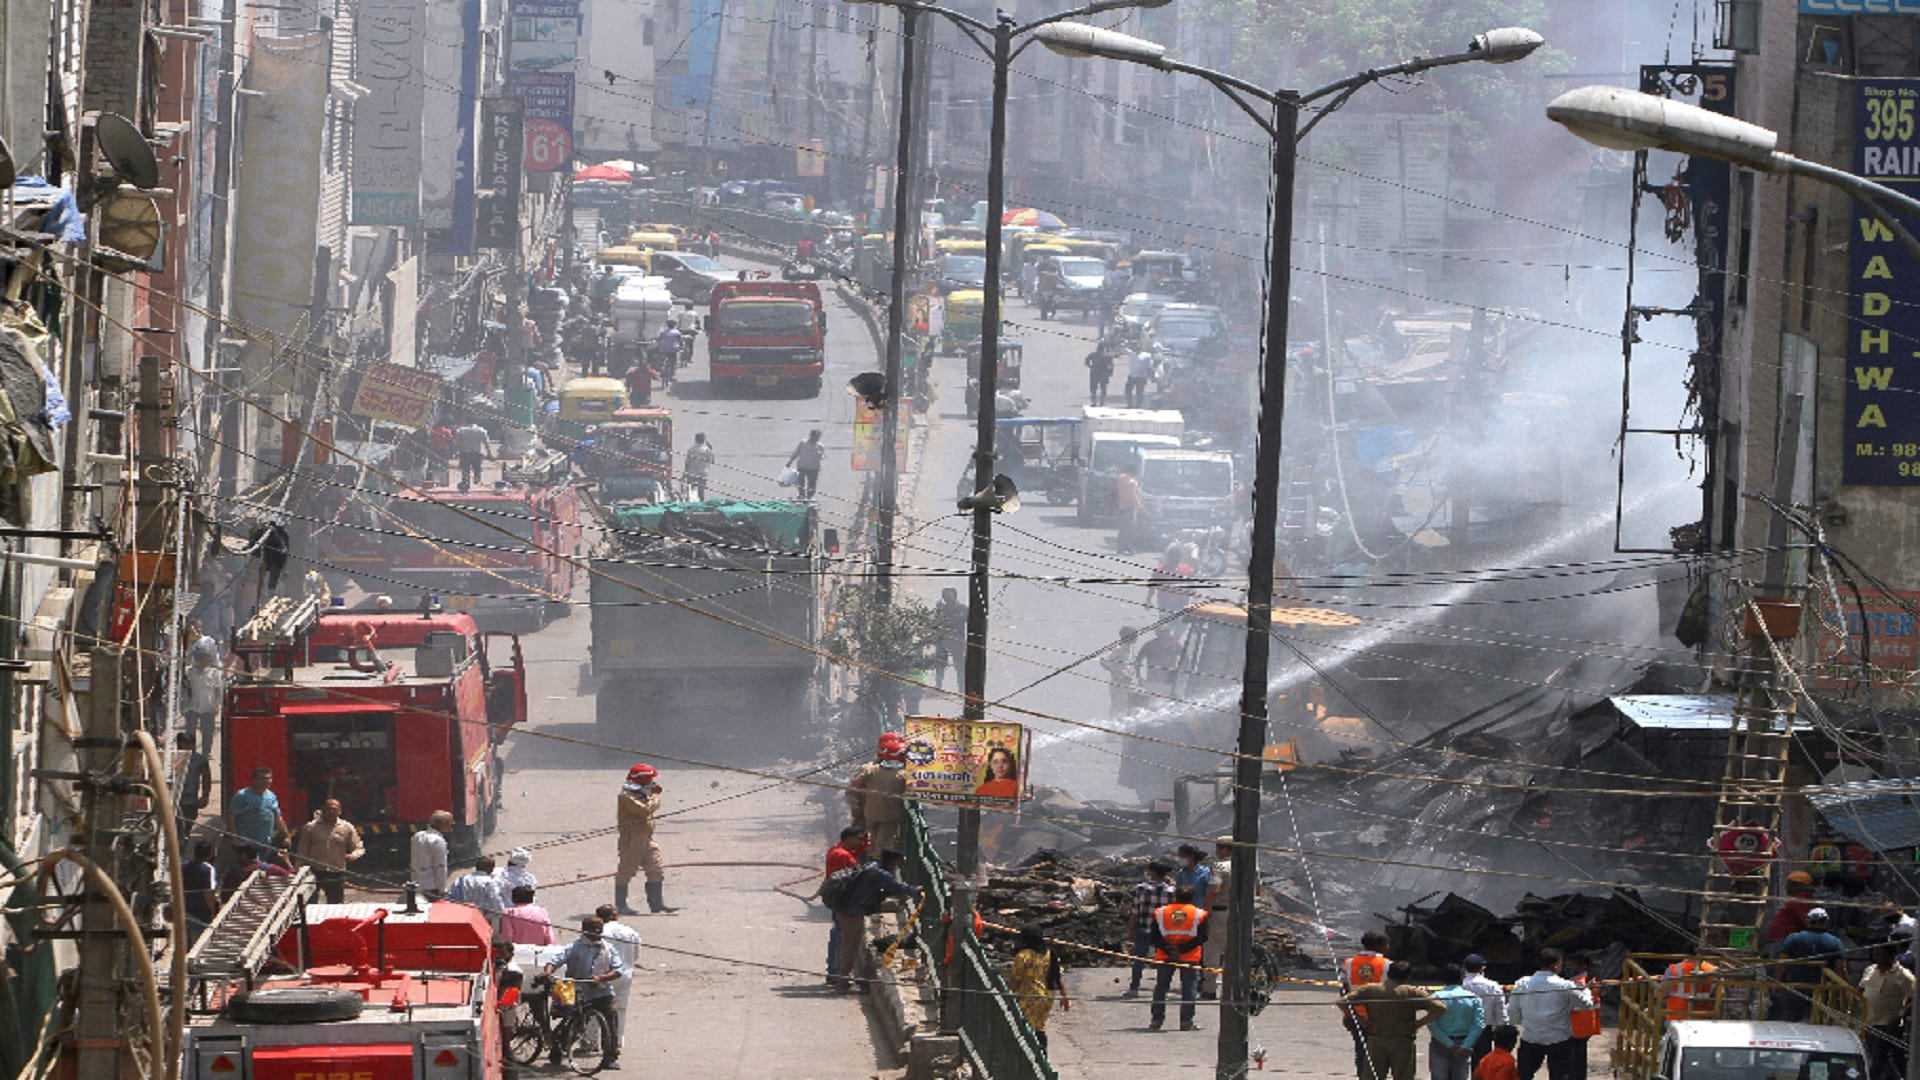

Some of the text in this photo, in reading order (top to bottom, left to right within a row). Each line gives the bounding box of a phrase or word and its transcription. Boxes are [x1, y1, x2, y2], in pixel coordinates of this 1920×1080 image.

[1864, 86, 1919, 98] Shop No.
[1864, 98, 1915, 141] 395
[532, 134, 565, 164] 61
[489, 114, 510, 238] KRISHAN LAL
[1854, 217, 1895, 429] WADHWA
[1892, 443, 1920, 458] 98
